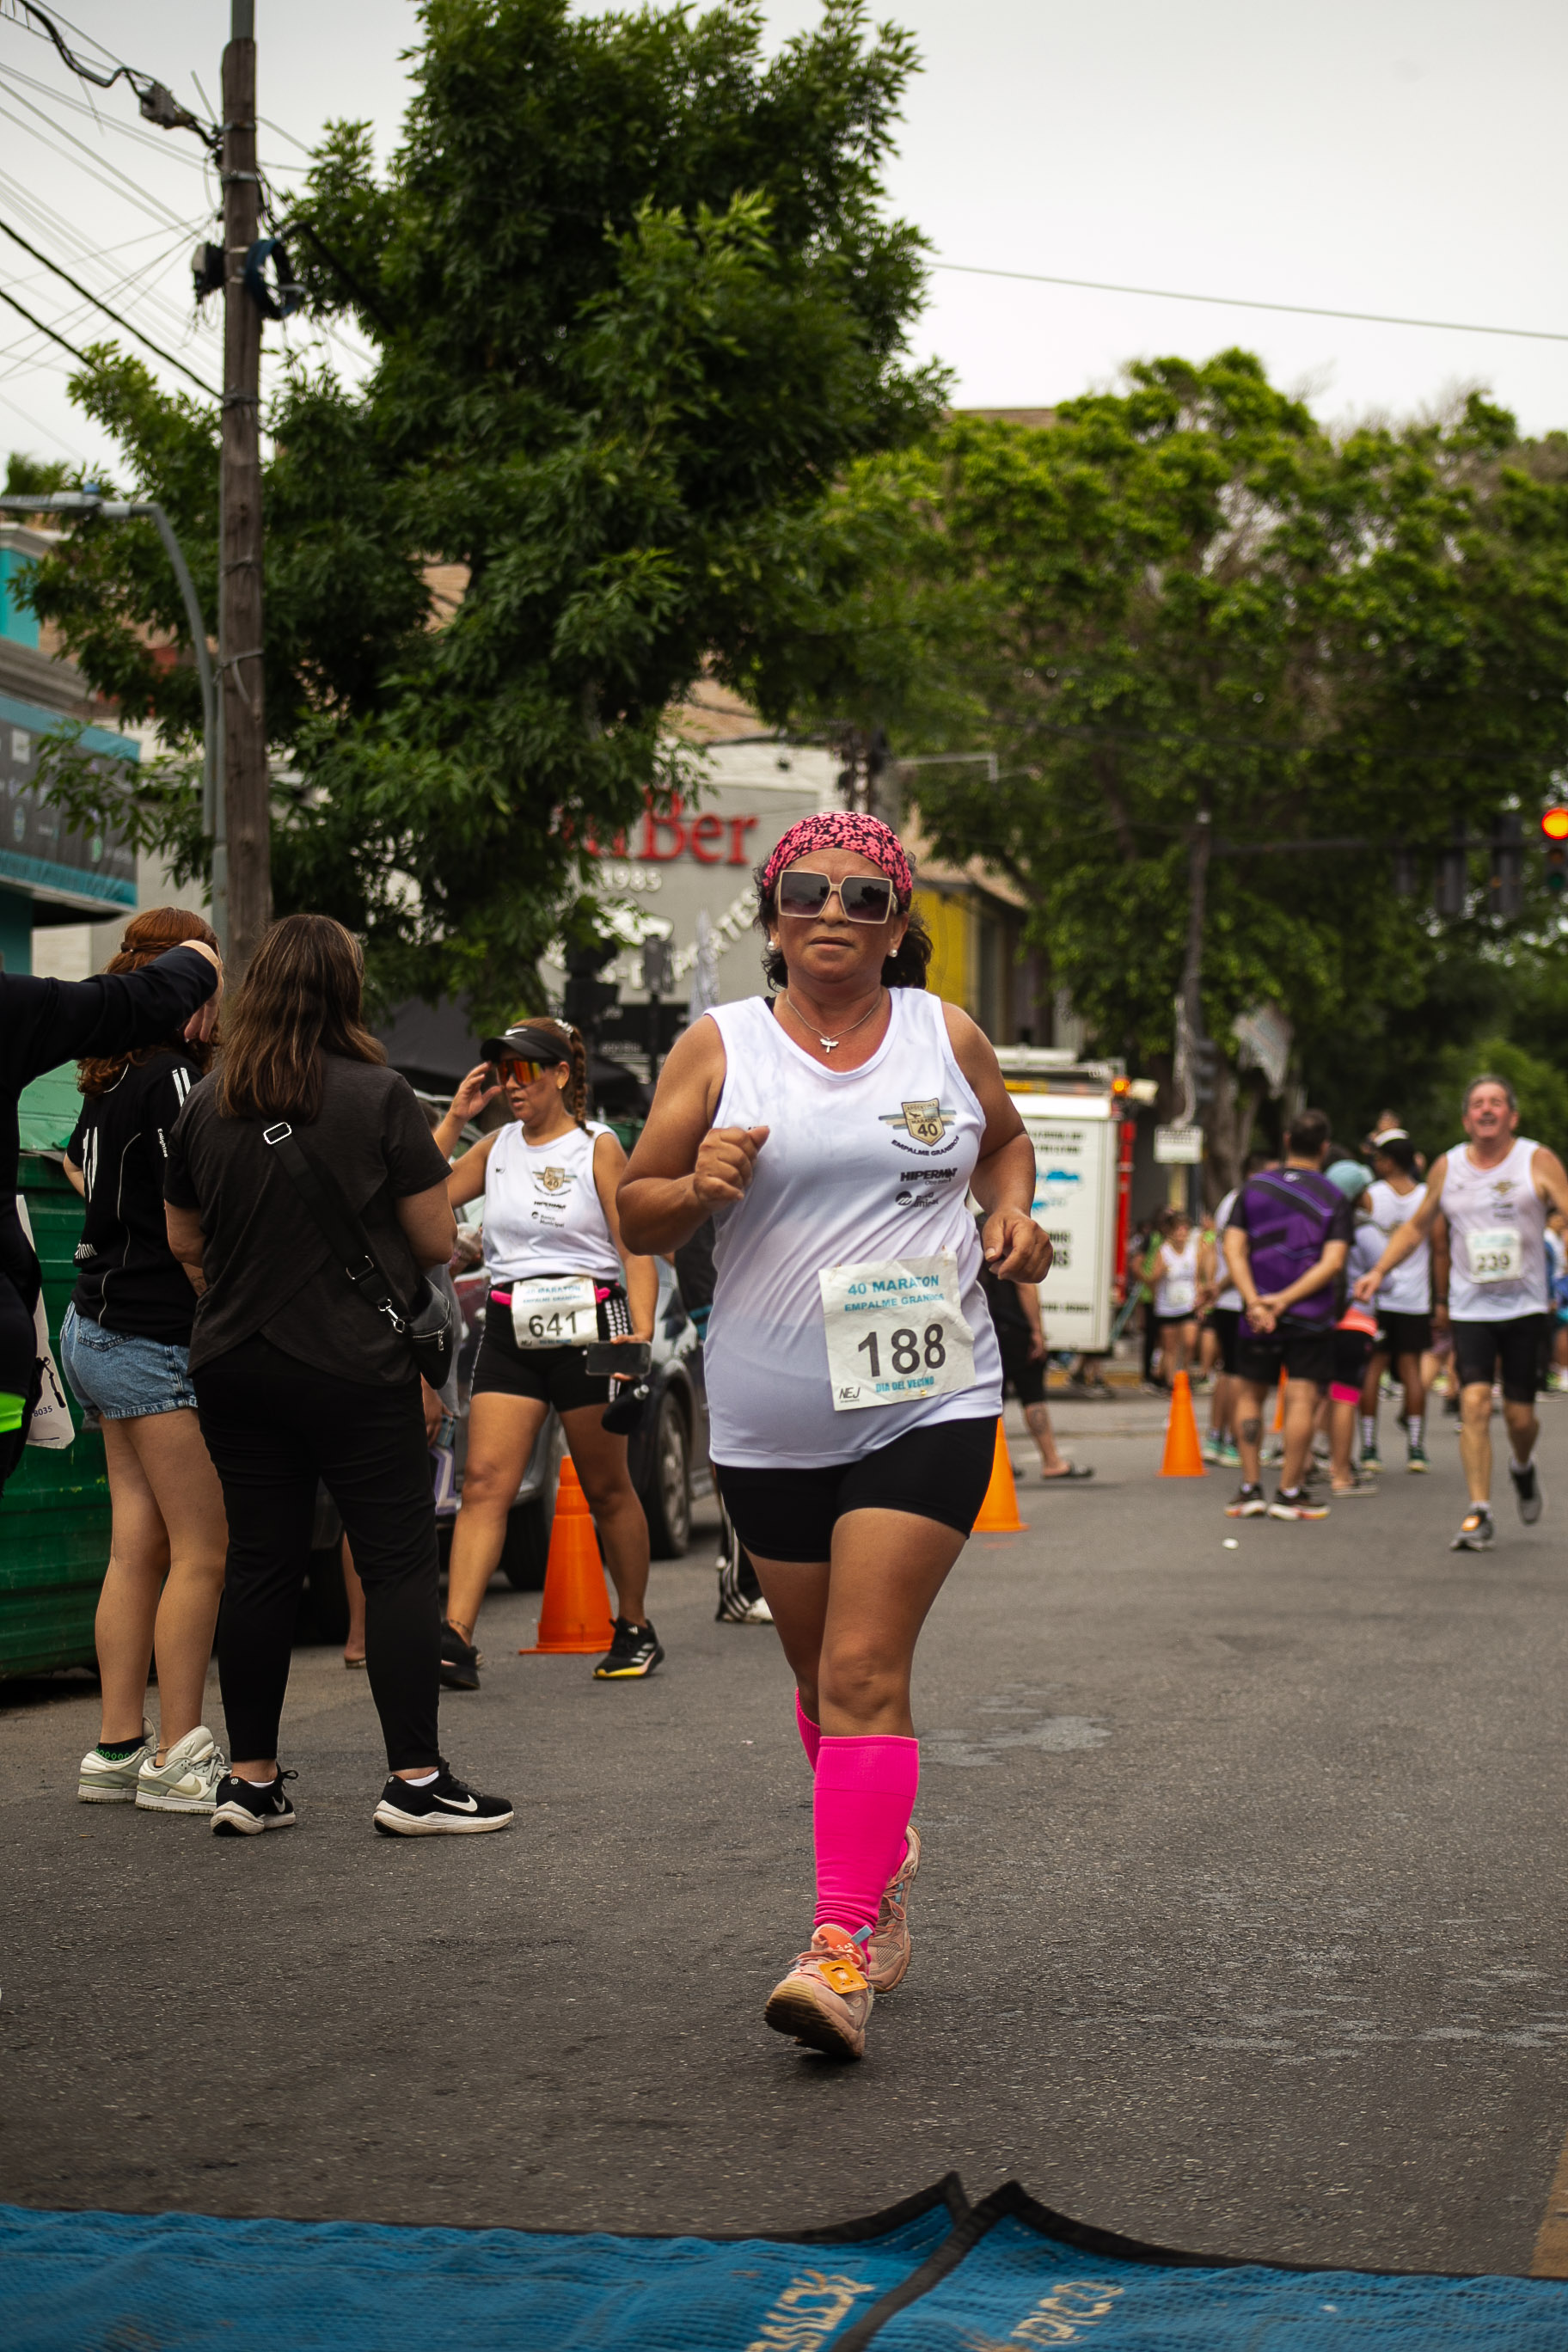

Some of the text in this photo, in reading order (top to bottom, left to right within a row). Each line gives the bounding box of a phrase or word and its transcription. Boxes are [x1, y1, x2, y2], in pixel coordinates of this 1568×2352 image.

[917, 1123, 938, 1136] 40
[891, 1135, 959, 1156] EMPALME GRANEROS
[900, 1167, 959, 1182] HIPERMT
[1477, 1252, 1511, 1272] 239
[848, 1275, 940, 1295] 40 MARATON
[844, 1298, 897, 1312] EMPALME
[529, 1311, 577, 1338] 641
[858, 1323, 946, 1378] 188
[839, 1387, 861, 1400] NEJ
[875, 1375, 934, 1393] DIA DEL VECINO
